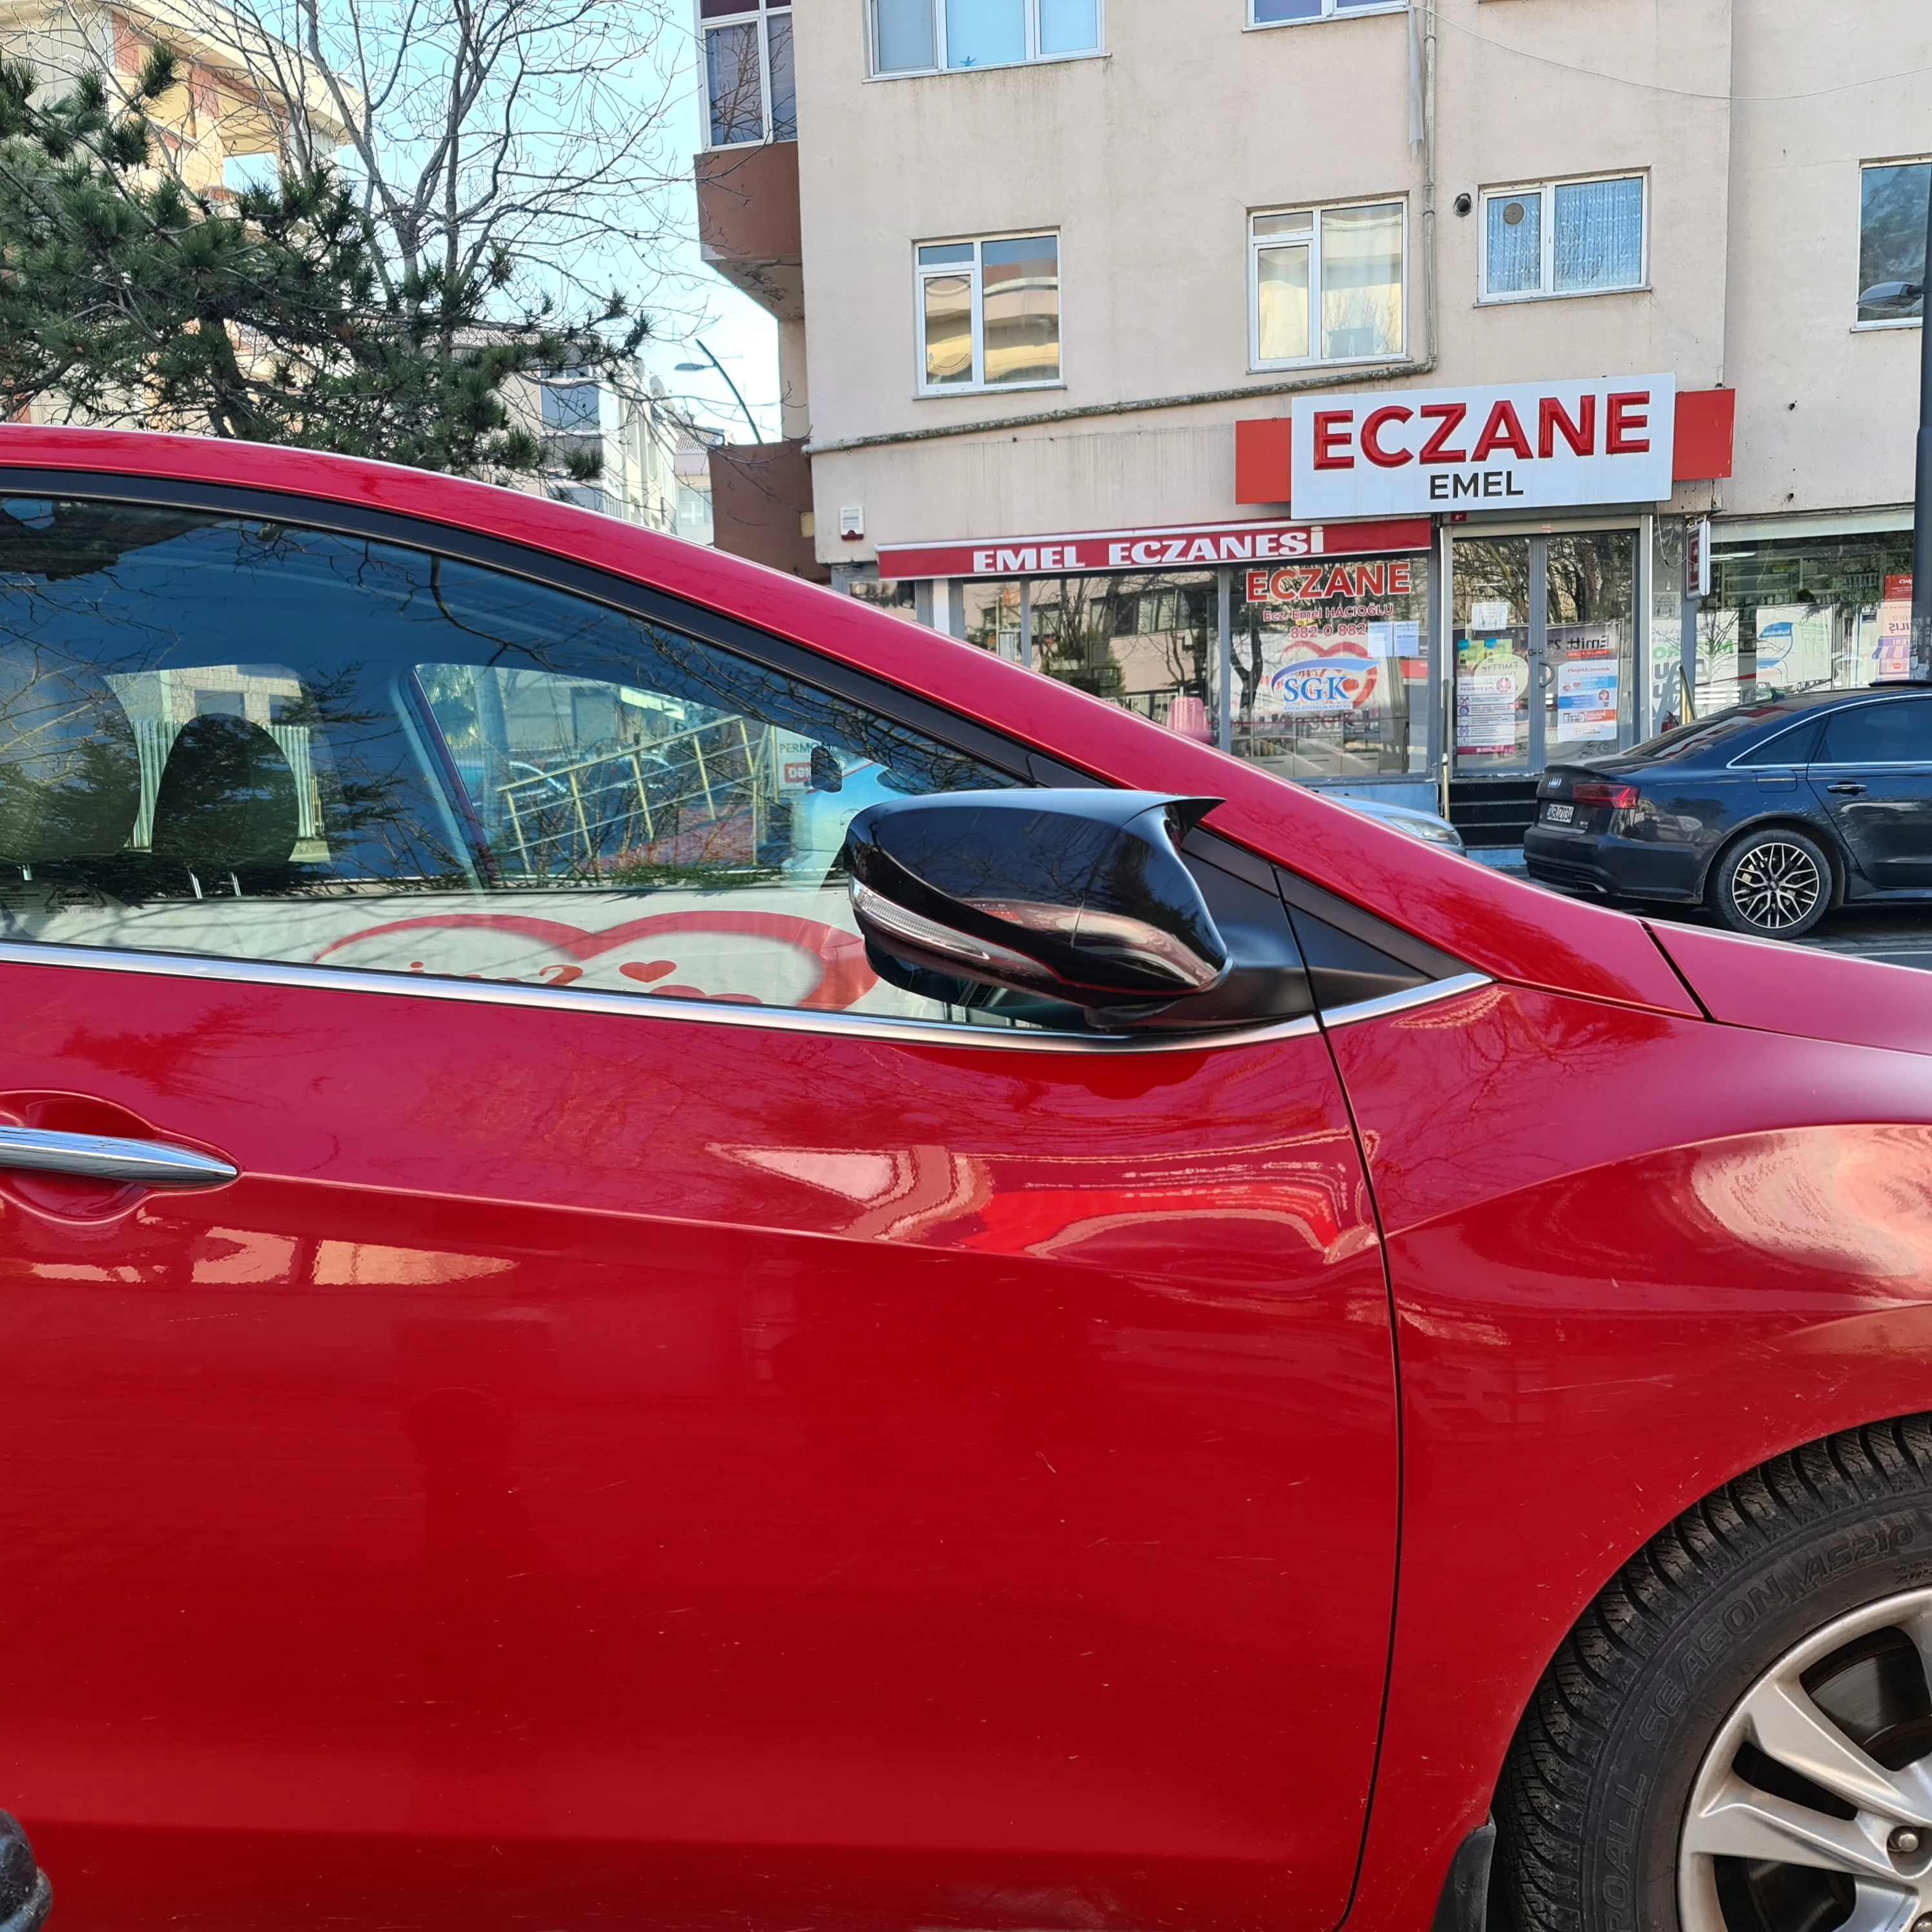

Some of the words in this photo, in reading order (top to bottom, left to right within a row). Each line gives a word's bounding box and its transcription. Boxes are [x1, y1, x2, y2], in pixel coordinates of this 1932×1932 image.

[1313, 391, 1650, 471] ECZANE
[1429, 471, 1524, 500] EMEL
[973, 545, 1085, 572] EMEL
[1109, 526, 1324, 566] ECZANESİ
[1246, 562, 1411, 602] ECZANE
[1264, 610, 1288, 621] Ecz.
[1292, 609, 1322, 620] Emel
[1326, 603, 1393, 618] HACIOĞLU
[1291, 626, 1318, 639] 882
[1323, 625, 1333, 637] 0
[1337, 623, 1366, 636] 882
[1283, 675, 1350, 703] SGK
[1639, 1574, 1785, 1749] SEASON
[1804, 1524, 1914, 1587] AS210
